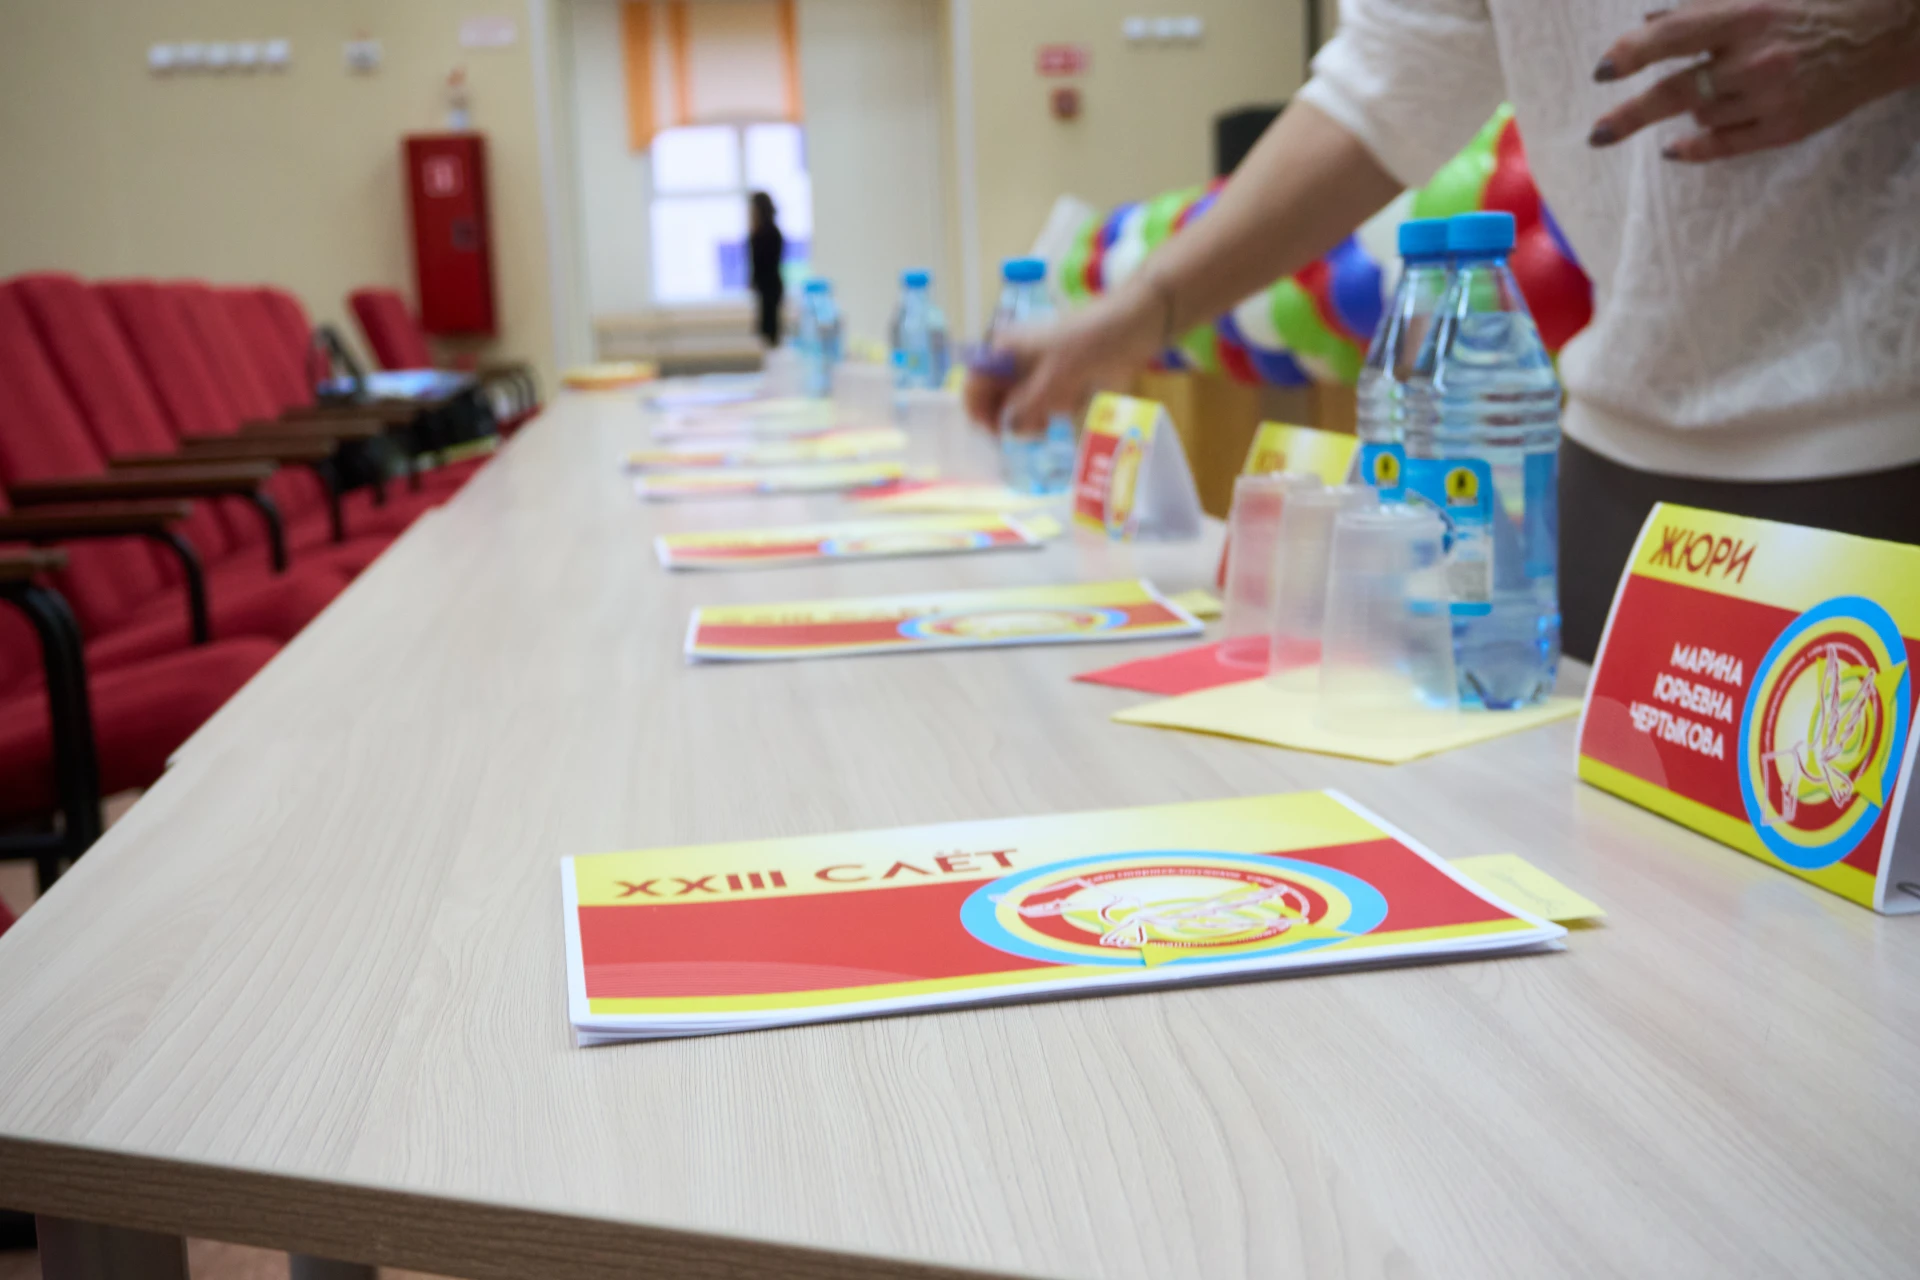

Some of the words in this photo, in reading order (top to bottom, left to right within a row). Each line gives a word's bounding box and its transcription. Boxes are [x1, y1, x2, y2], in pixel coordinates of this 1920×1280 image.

[1649, 525, 1757, 584] ЖЮРИ
[1670, 642, 1743, 686] МАРИНА
[1653, 671, 1733, 723] ЮРЬЕВНА
[1629, 701, 1724, 760] ЧЕРТЫКОВА
[614, 870, 788, 899] XXIII
[813, 848, 1018, 884] СЛЁТ
